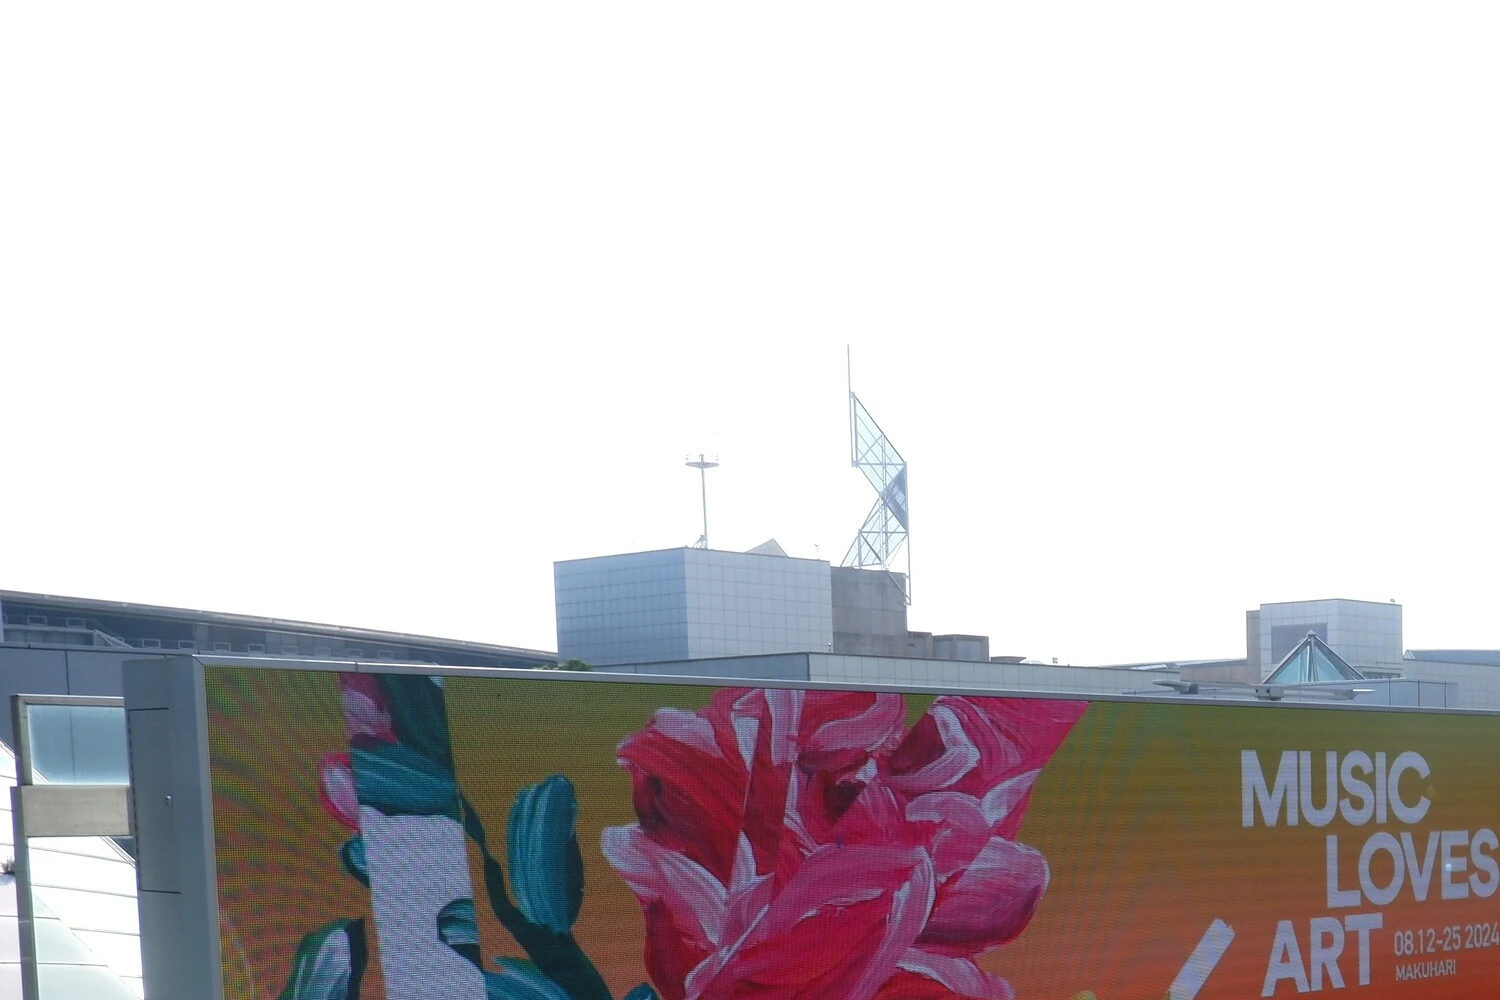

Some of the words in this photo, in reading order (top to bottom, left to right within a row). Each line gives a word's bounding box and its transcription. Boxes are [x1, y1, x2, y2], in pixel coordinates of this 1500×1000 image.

[1241, 749, 1431, 827] MUSIC
[1326, 828, 1500, 909] LOVES
[1261, 912, 1383, 998] ART
[1394, 925, 1462, 957] 08.12-25
[1464, 921, 1500, 949] 2024
[1395, 959, 1457, 982] MAKUHARI
